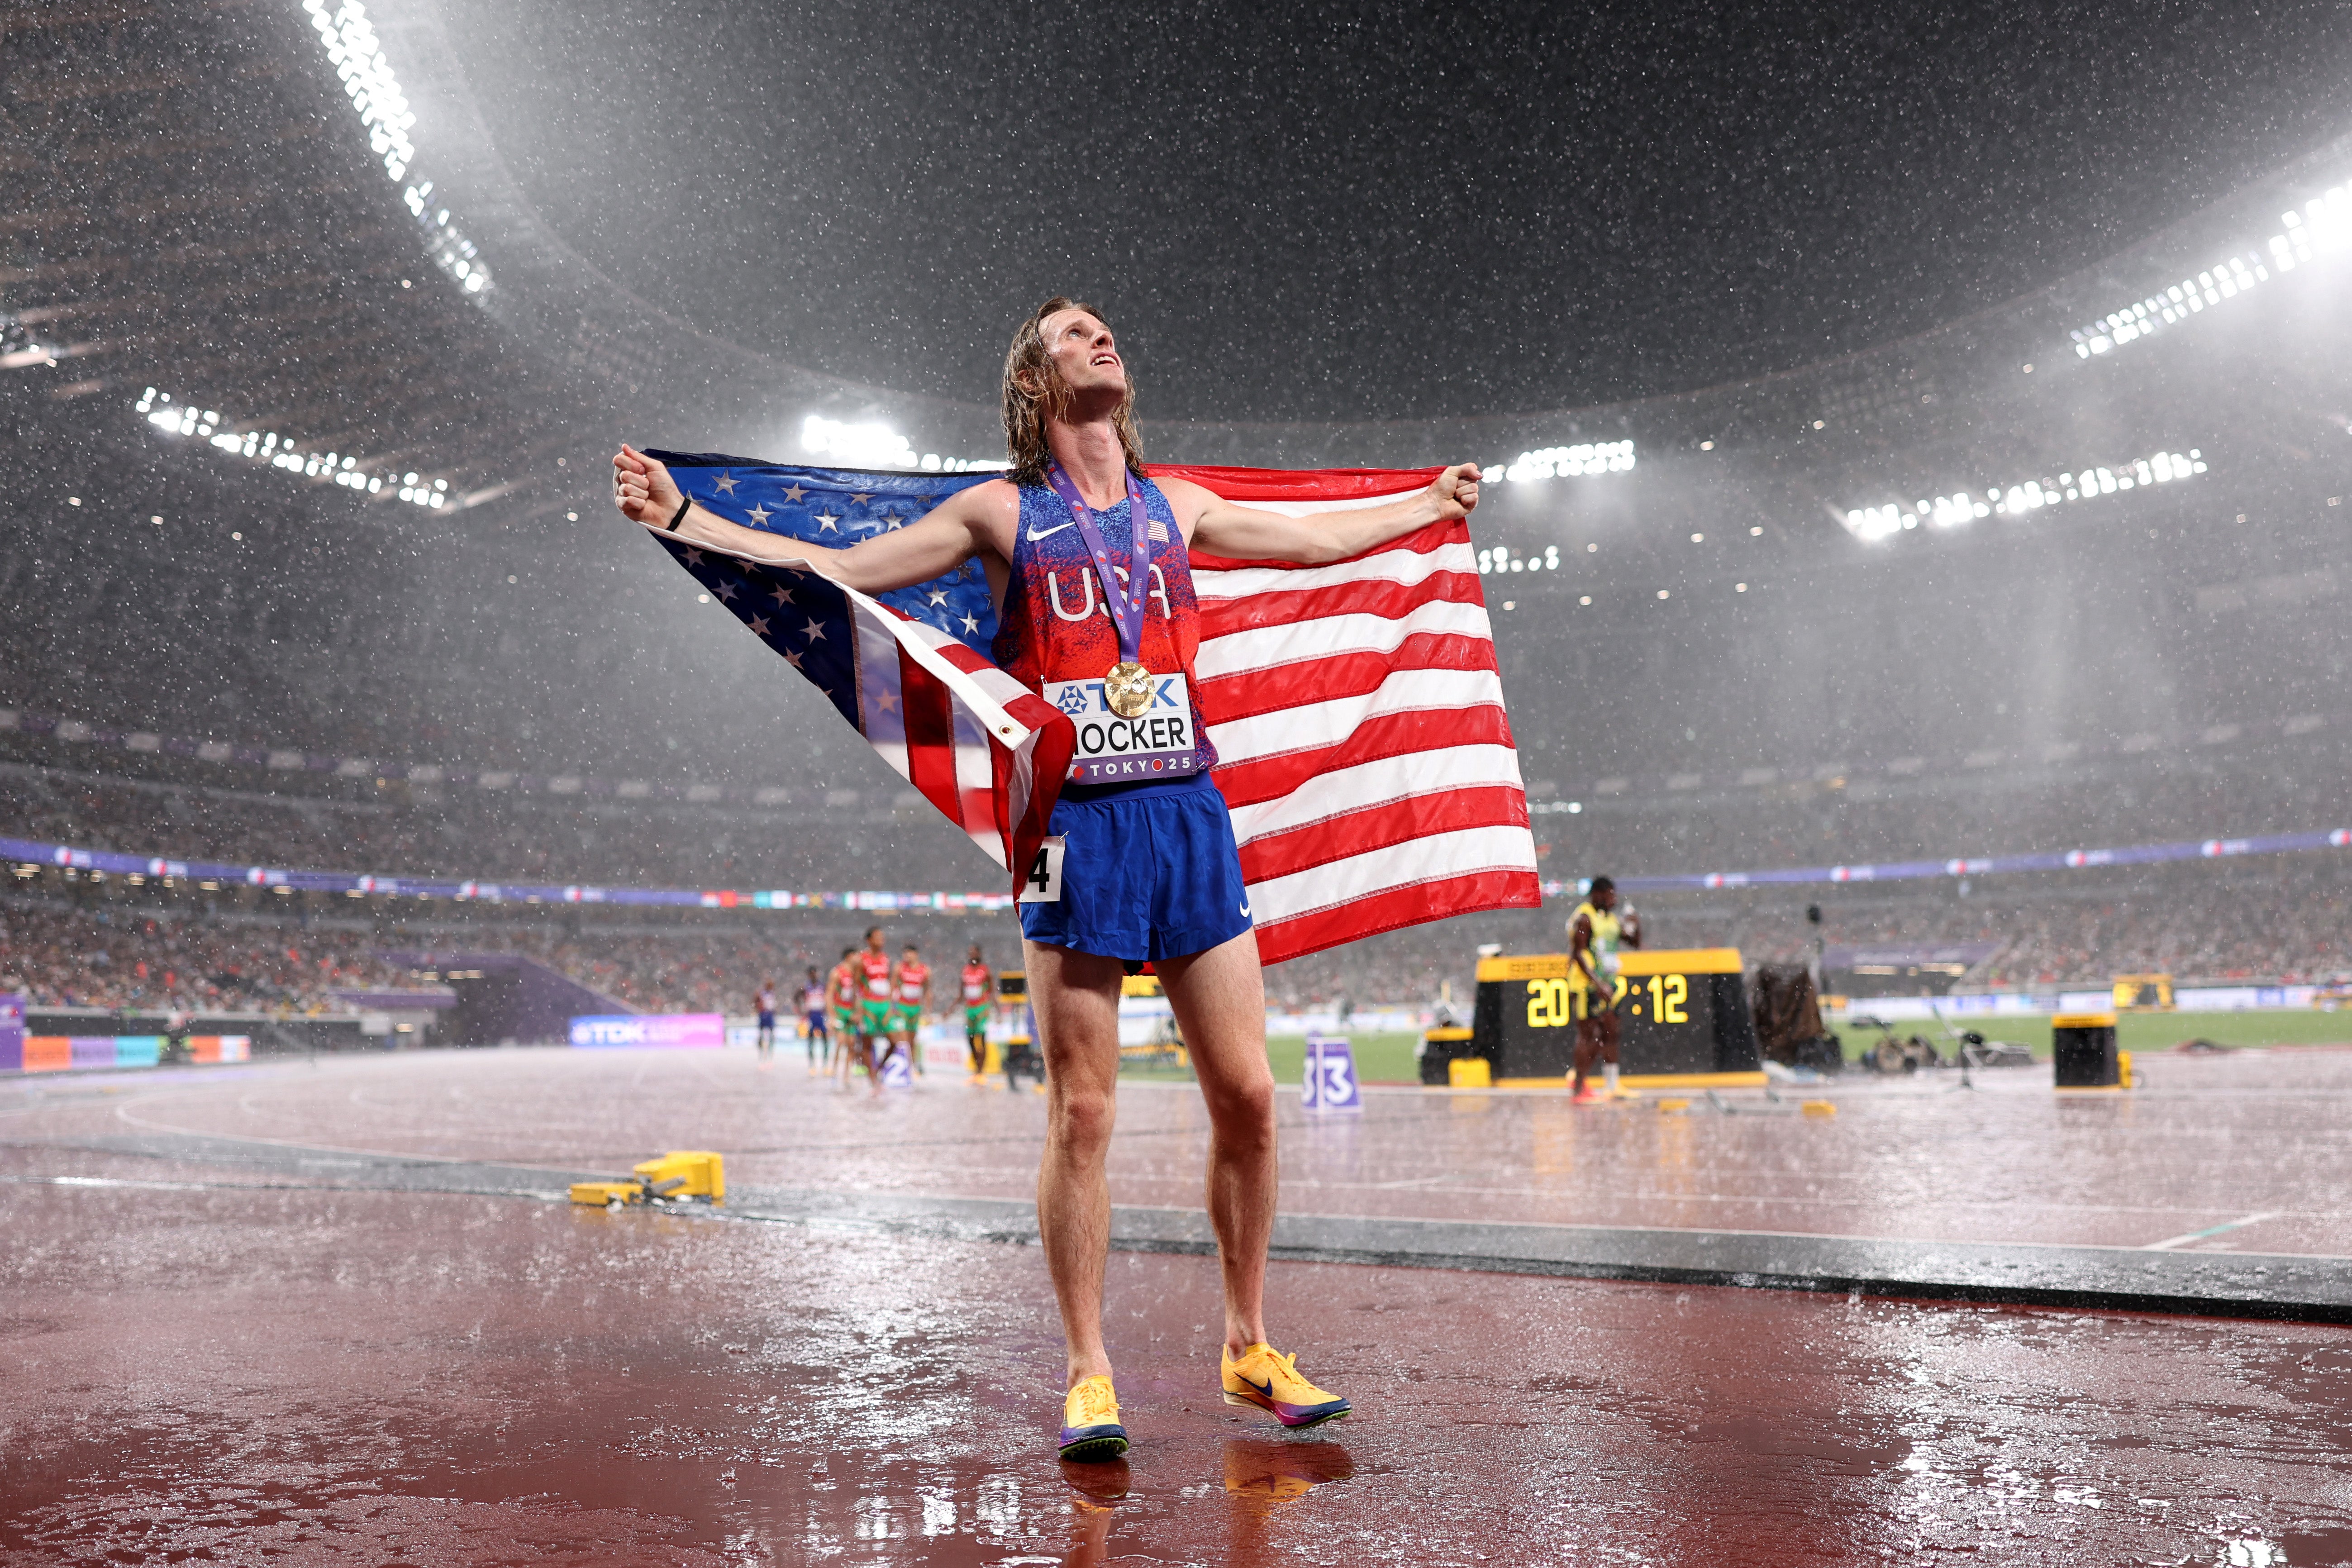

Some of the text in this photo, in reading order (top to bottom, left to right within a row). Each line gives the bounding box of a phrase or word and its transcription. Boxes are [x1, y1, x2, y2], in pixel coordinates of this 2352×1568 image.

[1047, 564, 1171, 621] USA
[1086, 679, 1179, 711] TK
[1028, 848, 1050, 893] 4
[1527, 978, 1570, 1028] 20
[883, 1053, 909, 1085] 2
[1323, 1056, 1354, 1104] 3
